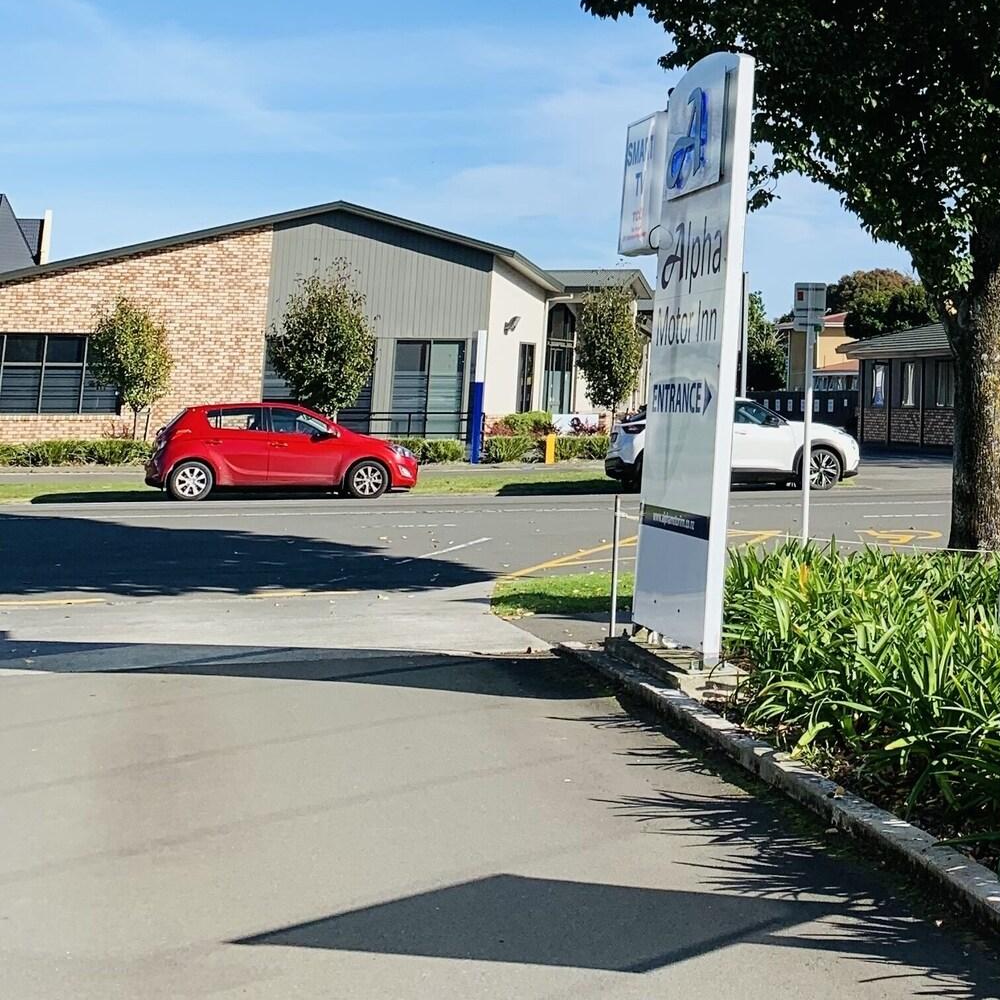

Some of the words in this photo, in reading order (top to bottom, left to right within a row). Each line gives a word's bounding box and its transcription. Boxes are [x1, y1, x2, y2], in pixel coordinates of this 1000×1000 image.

[661, 216, 722, 294] Alpha
[656, 306, 694, 347] Motor
[696, 300, 718, 343] Inn
[652, 382, 703, 414] ENTRANCE
